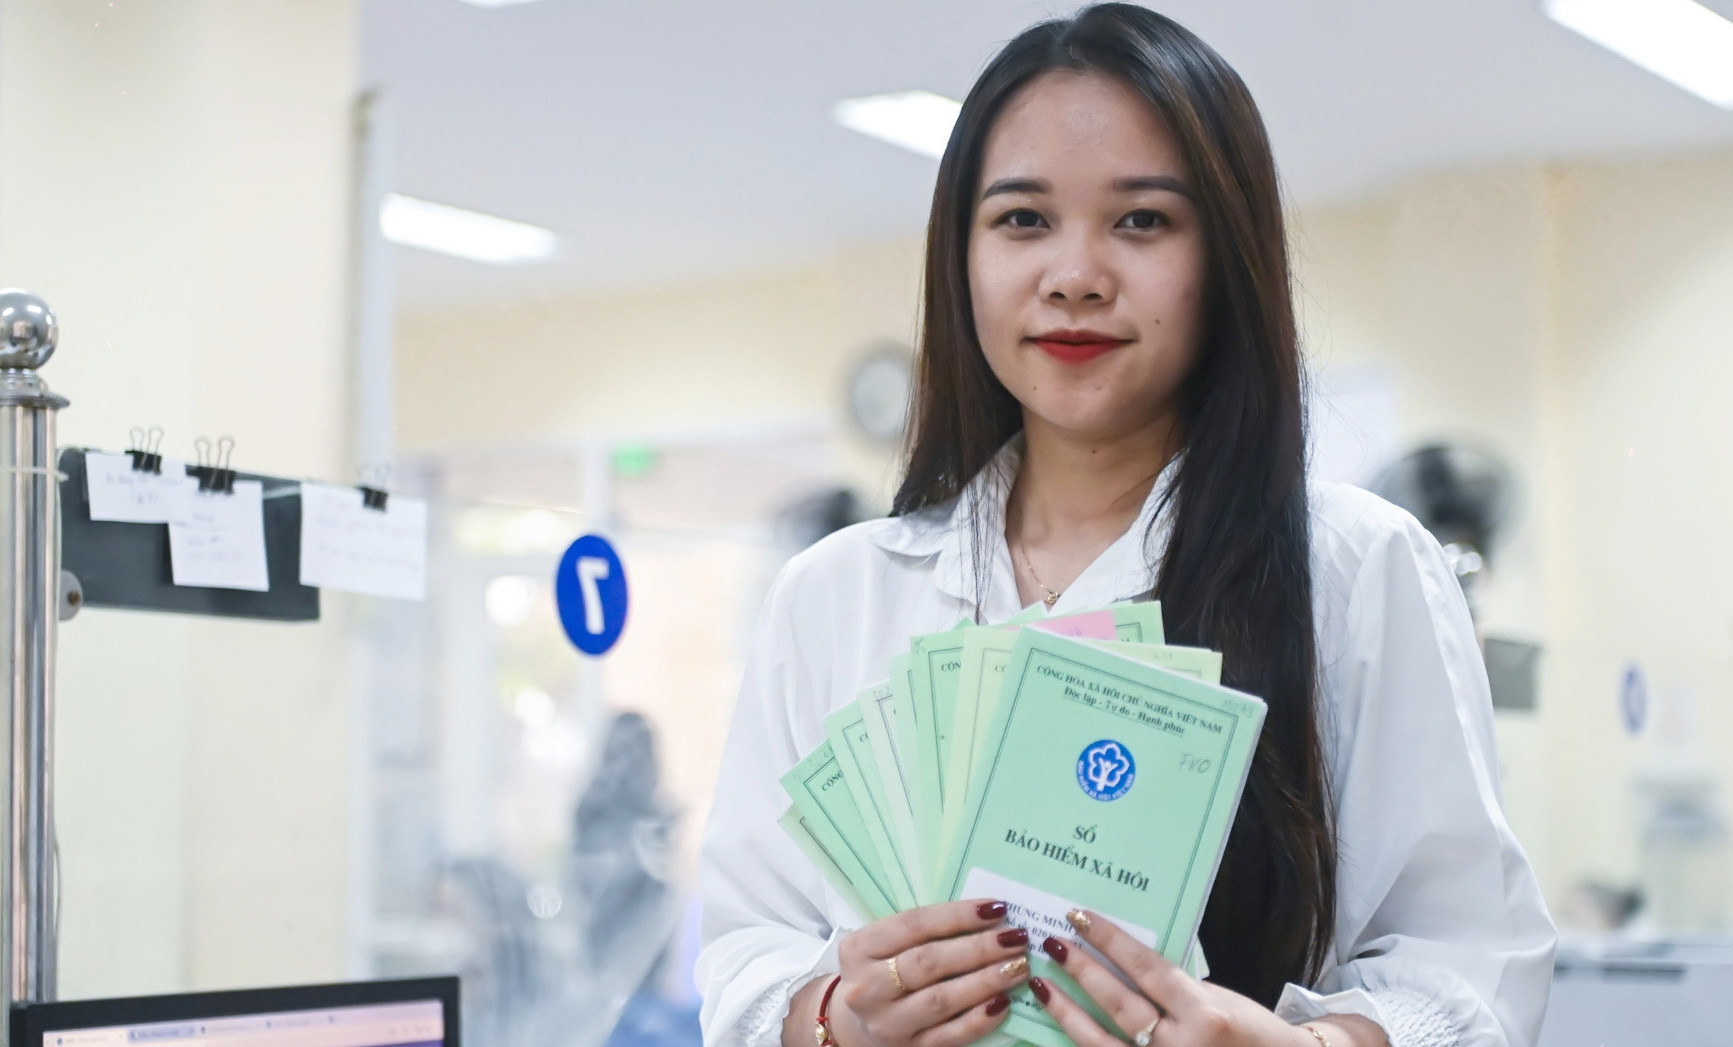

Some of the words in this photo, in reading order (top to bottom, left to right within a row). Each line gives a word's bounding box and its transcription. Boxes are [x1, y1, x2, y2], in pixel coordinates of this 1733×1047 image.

[1199, 719, 1223, 734] NAM
[1005, 829, 1040, 852] BẢO
[1042, 842, 1087, 869] HIỂM
[1090, 859, 1113, 879] XÃ
[1116, 869, 1150, 891] HỘI
